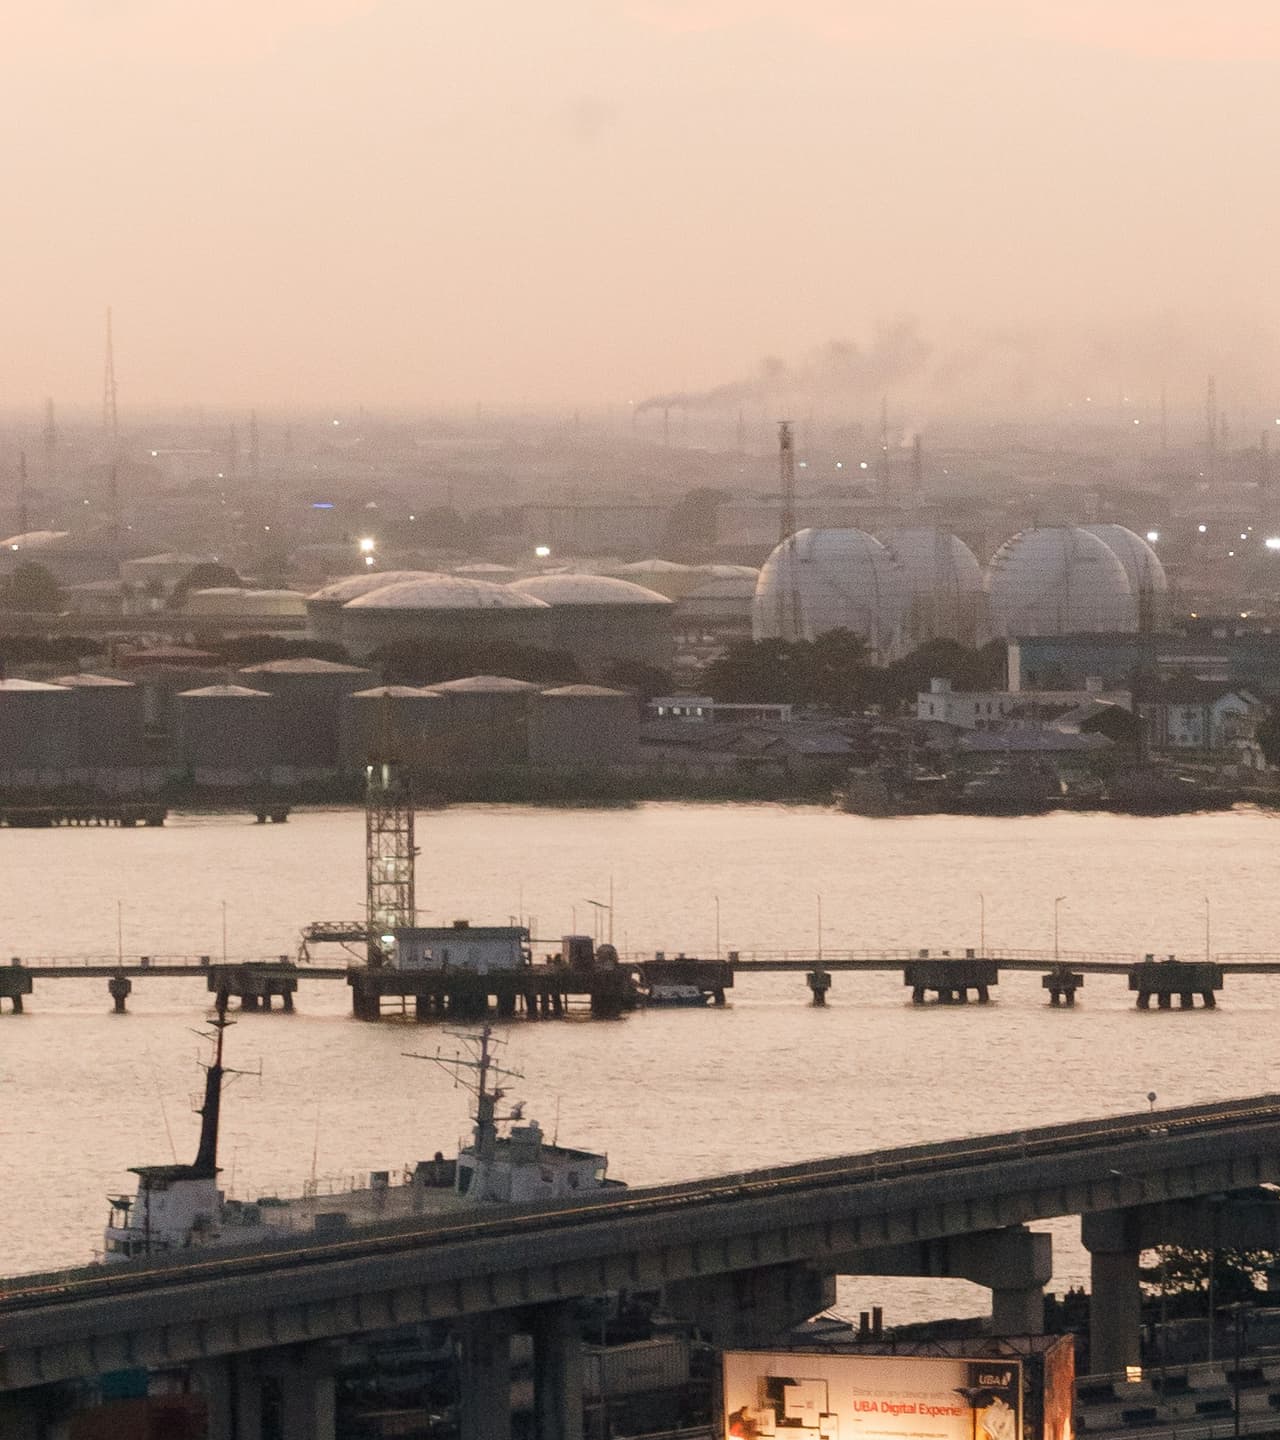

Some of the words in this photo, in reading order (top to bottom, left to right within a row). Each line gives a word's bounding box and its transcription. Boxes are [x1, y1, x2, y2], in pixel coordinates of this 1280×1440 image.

[854, 1401, 878, 1412] UBA
[881, 1402, 916, 1417] Digital
[920, 1403, 969, 1418] Experie
